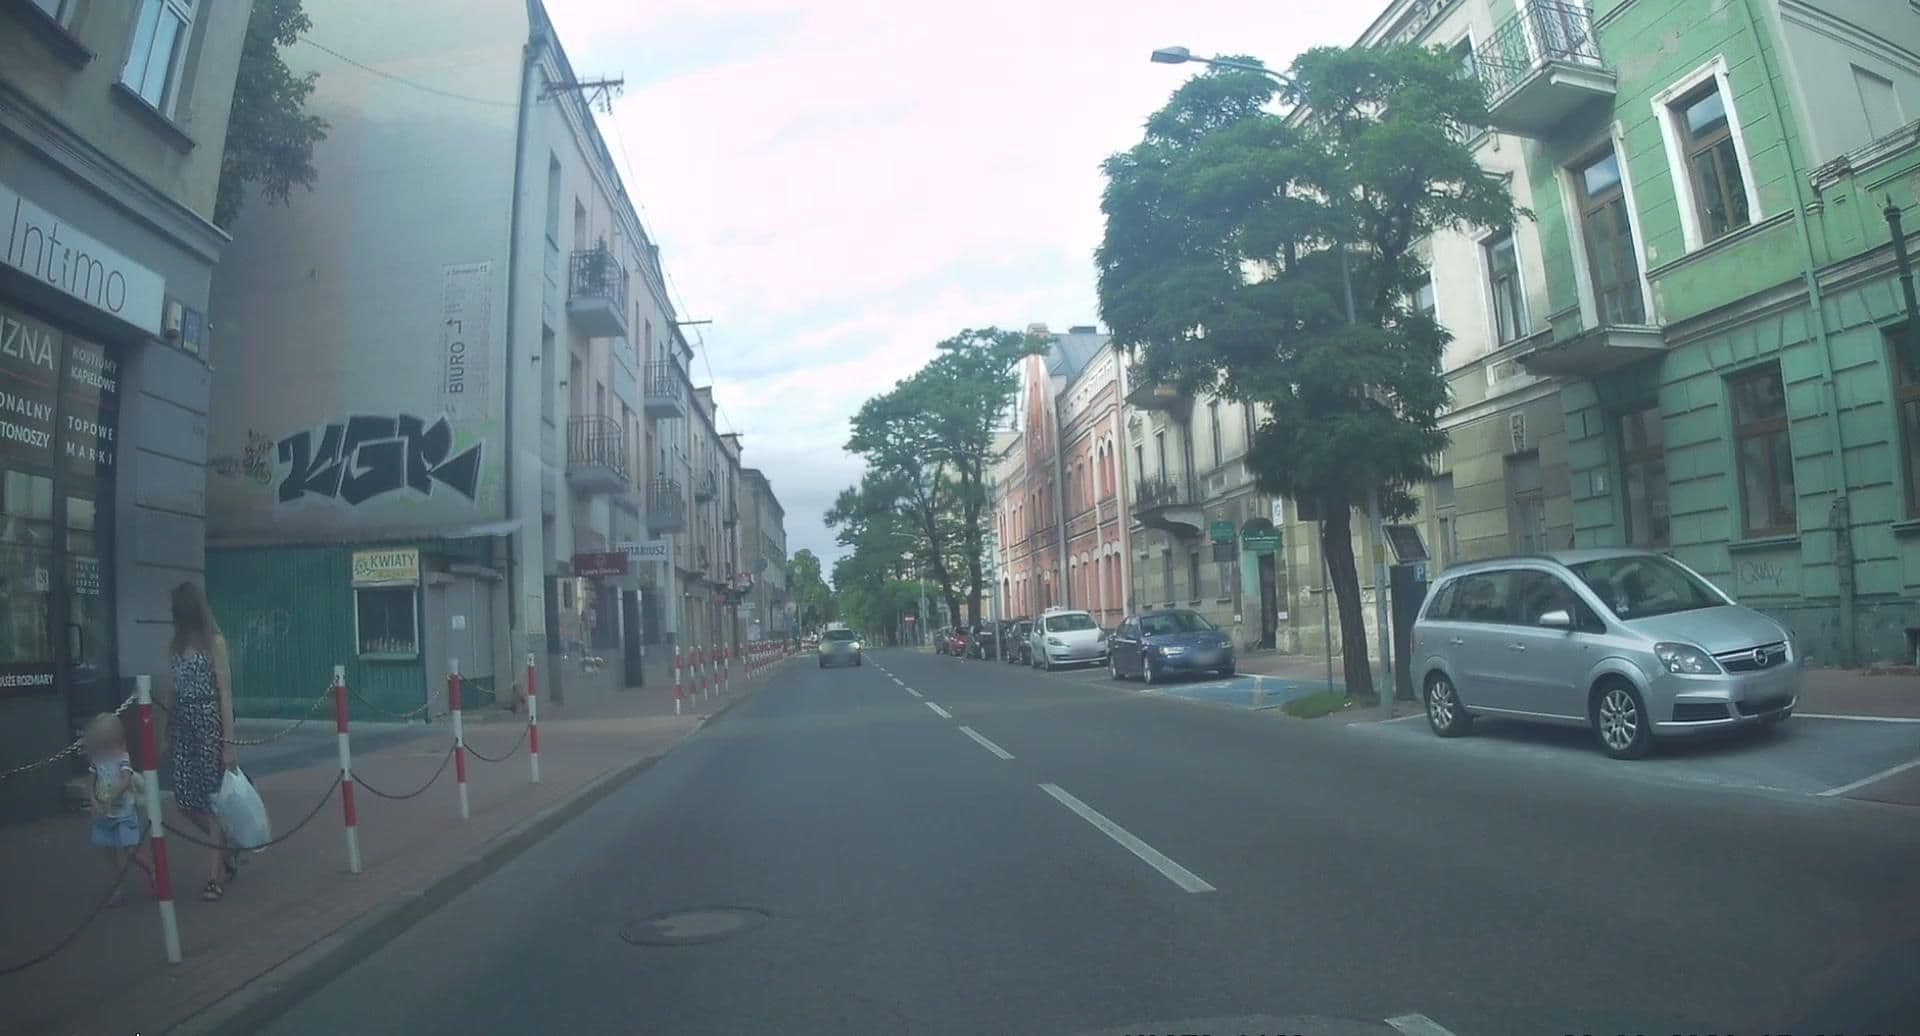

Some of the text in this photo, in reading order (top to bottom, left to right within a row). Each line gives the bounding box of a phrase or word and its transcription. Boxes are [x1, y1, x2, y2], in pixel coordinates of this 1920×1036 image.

[7, 196, 128, 313] Intimo
[71, 345, 117, 374] KOSTIUMY
[448, 342, 466, 394] BIURO
[67, 415, 113, 441] TOPOWE
[66, 441, 113, 465] MARKI
[370, 552, 416, 568] KWIATY
